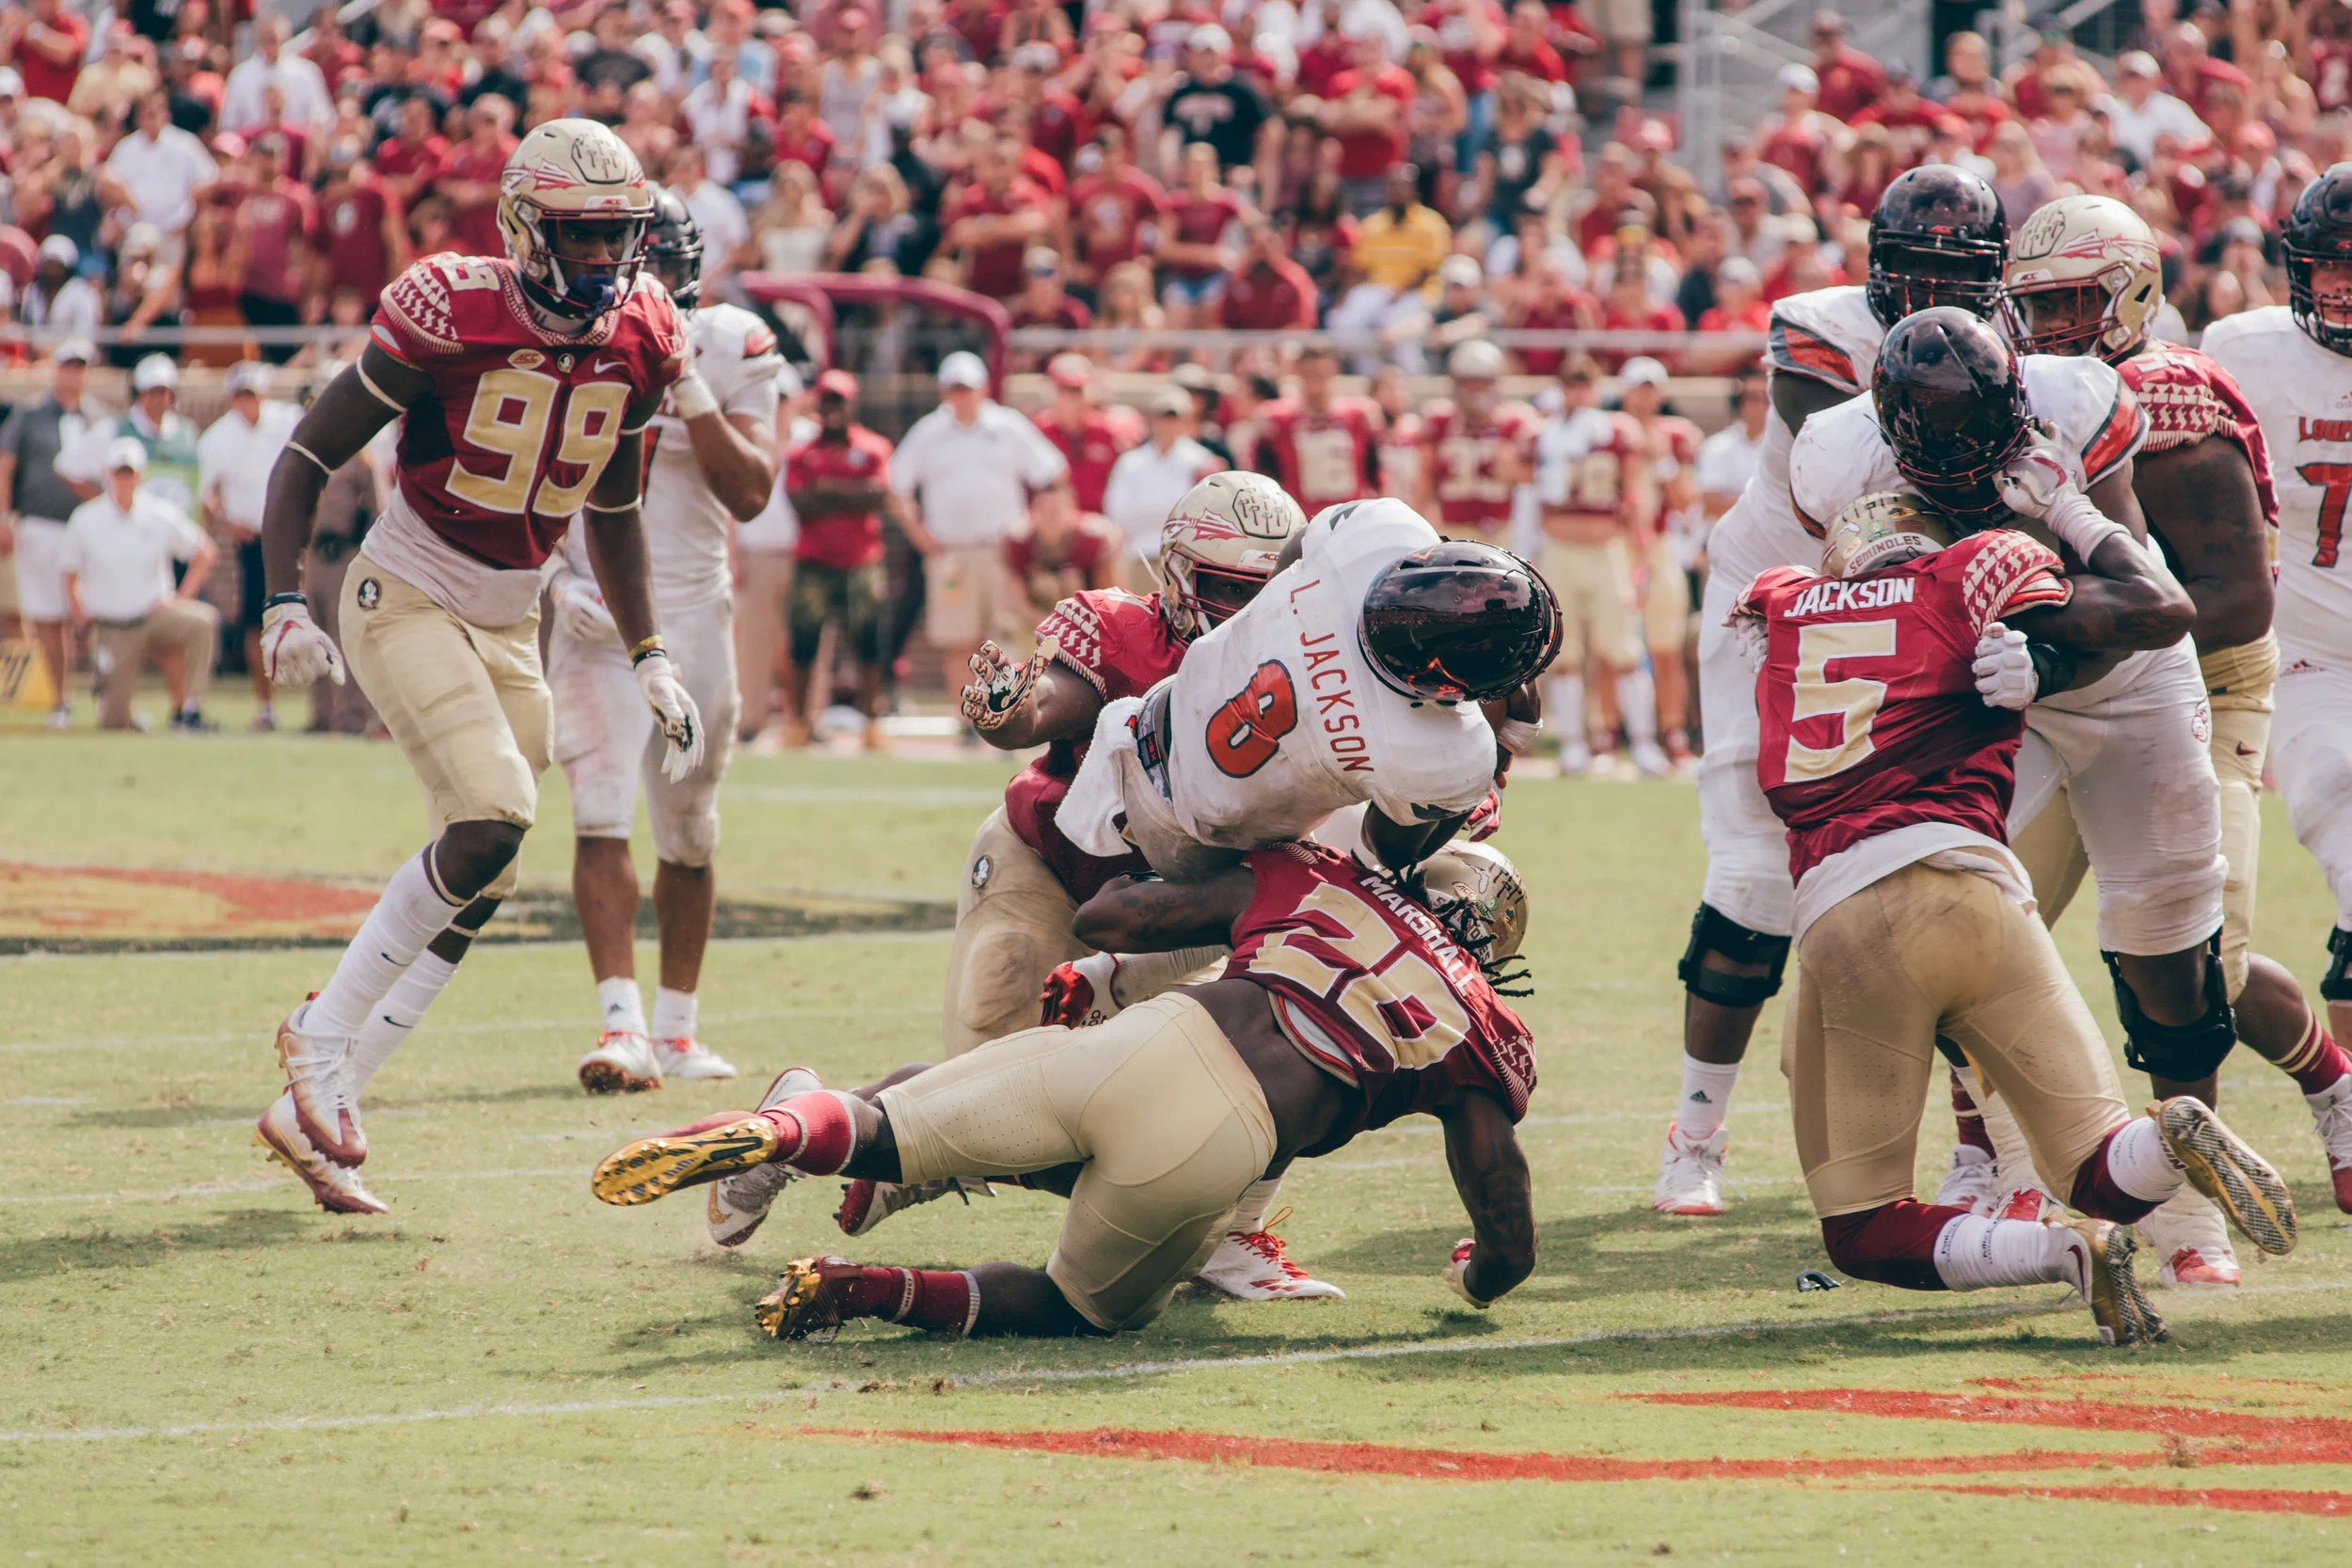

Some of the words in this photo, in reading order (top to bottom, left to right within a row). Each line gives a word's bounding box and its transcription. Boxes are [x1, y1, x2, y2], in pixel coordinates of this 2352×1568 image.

[514, 353, 539, 364] ACC
[444, 368, 632, 517] 99
[1849, 535, 1923, 575] SEMINOLES
[1290, 579, 1321, 615] L.
[1783, 577, 1915, 618] JACKSON
[1204, 658, 1298, 780] 8
[1299, 632, 1375, 773] JACKSON
[1784, 618, 1898, 783] 5
[1457, 884, 1477, 899] ACC
[1359, 876, 1475, 997] MARSHALL
